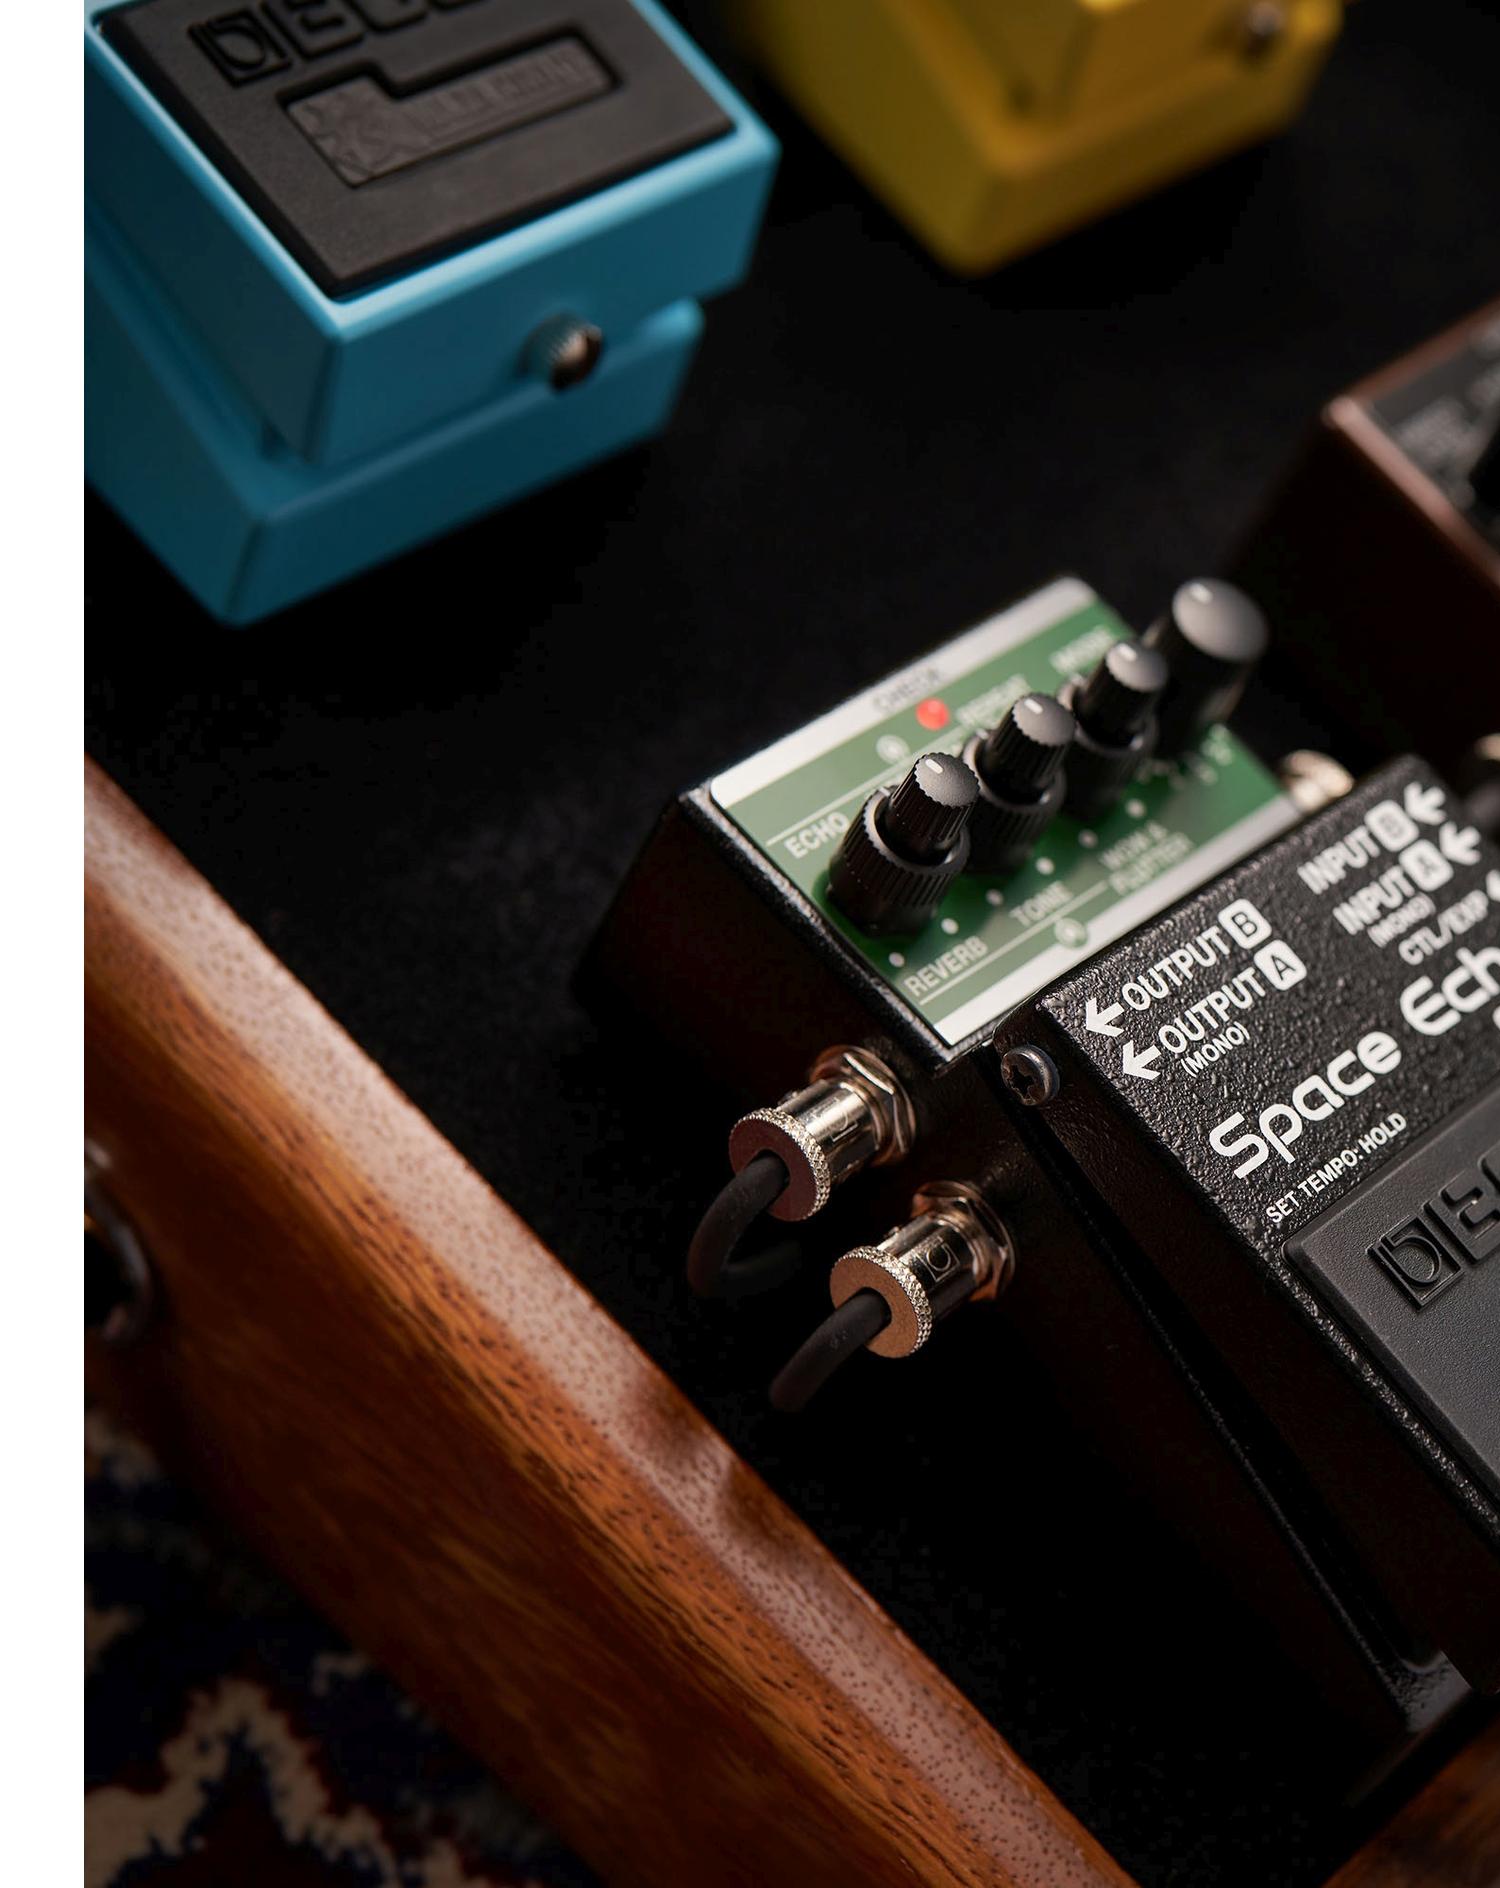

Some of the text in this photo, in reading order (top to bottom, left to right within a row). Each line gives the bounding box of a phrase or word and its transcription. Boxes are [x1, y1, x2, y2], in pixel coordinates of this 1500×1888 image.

[785, 812, 851, 860] ECHO
[1297, 824, 1381, 895] INPUT
[1009, 880, 1075, 928] TONE
[1332, 864, 1416, 936] INPUT
[903, 935, 990, 998] REVERB
[1121, 925, 1231, 1011] OUTPUT
[1158, 967, 1266, 1054] OUTPUT
[1180, 1021, 1251, 1078] (MONO)
[1209, 1031, 1402, 1179] Space
[1265, 1112, 1407, 1223] SET TEMPO: HOLD
